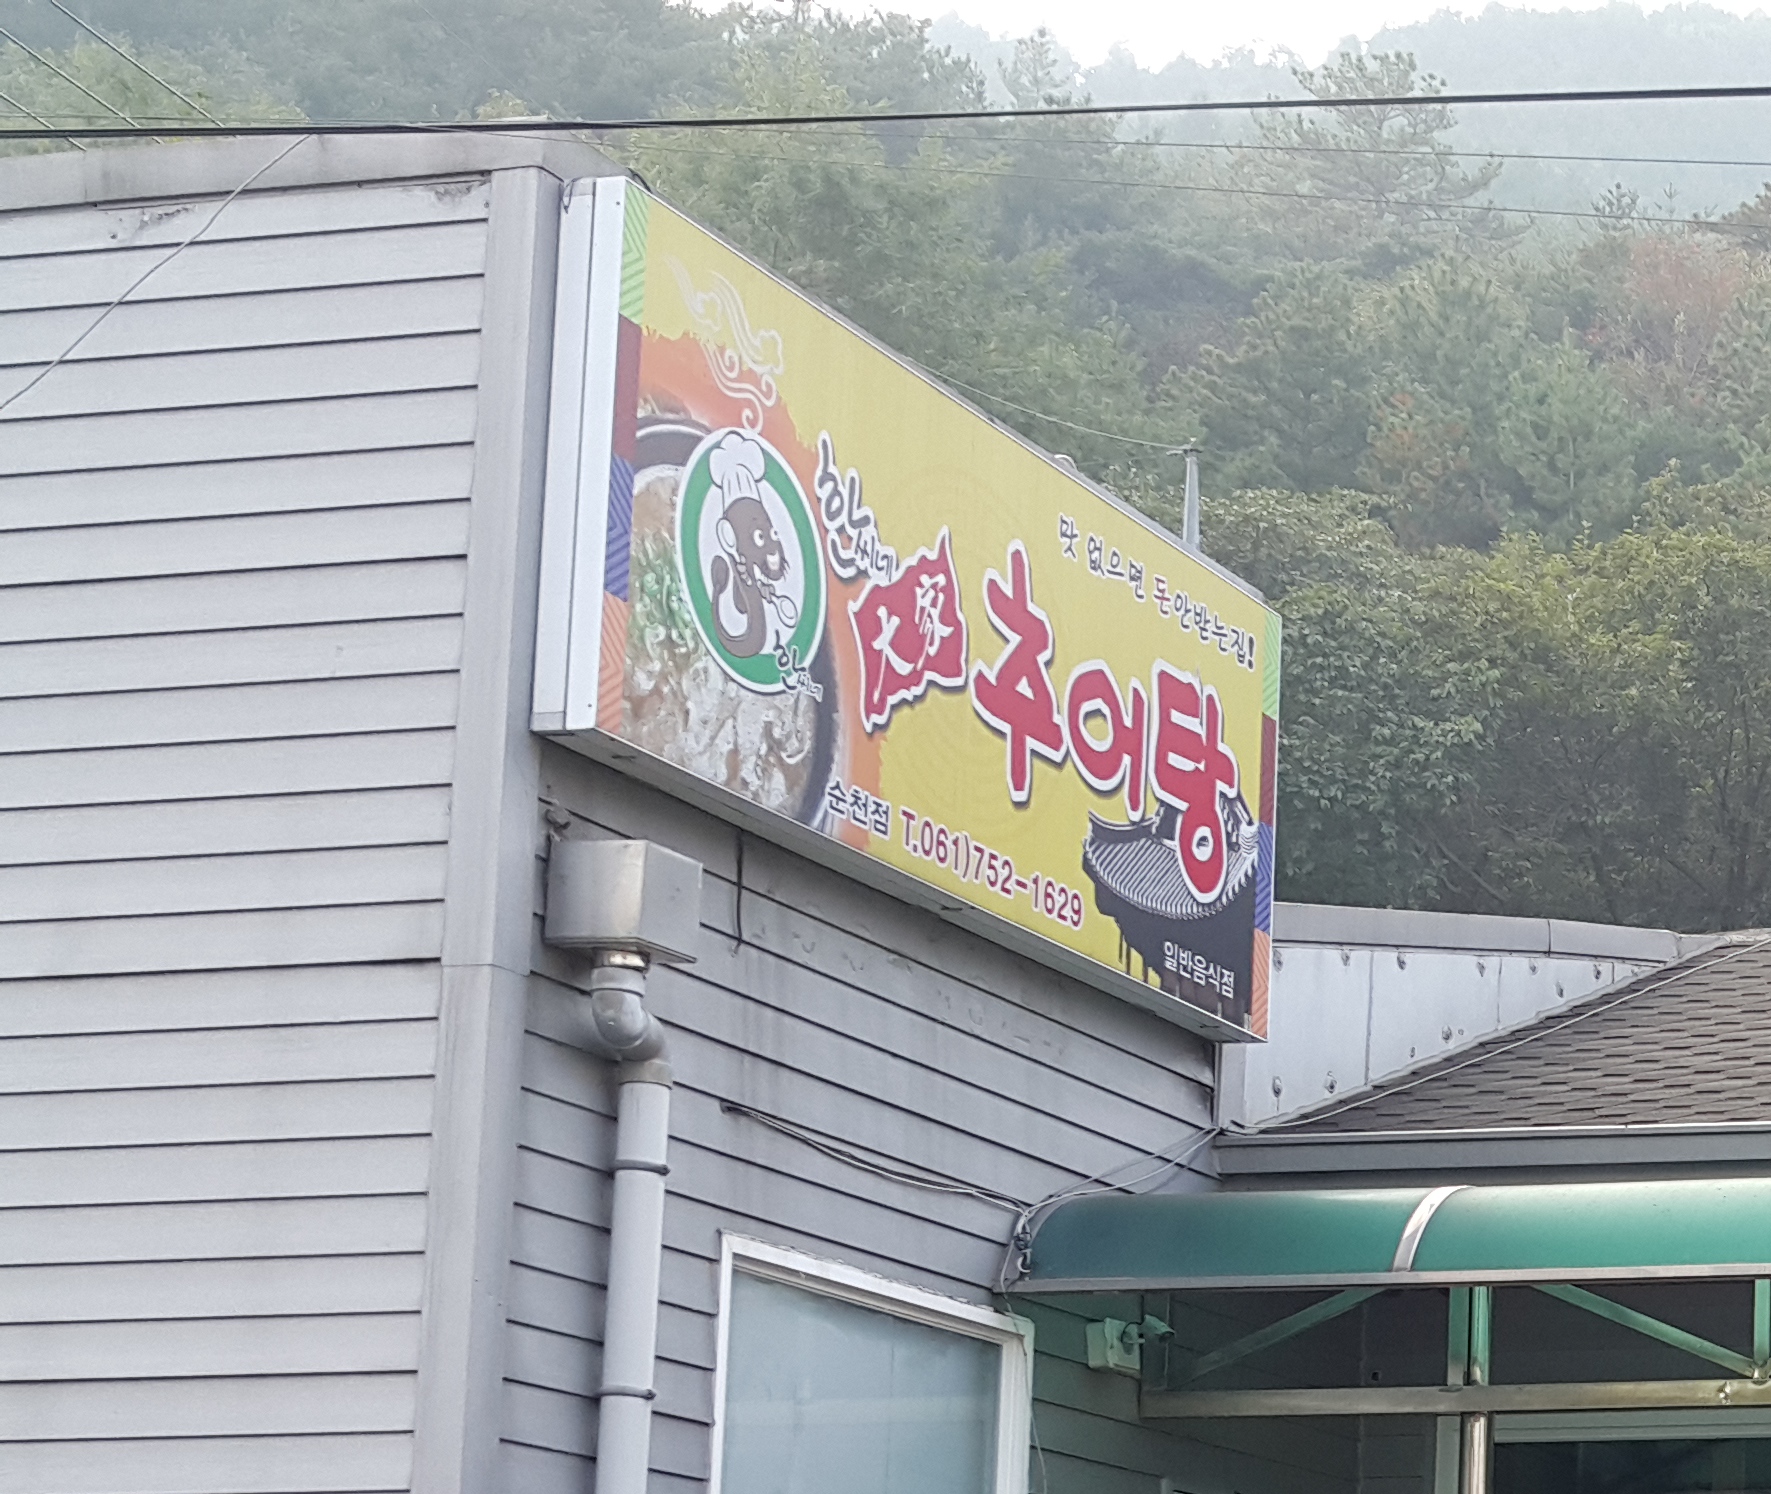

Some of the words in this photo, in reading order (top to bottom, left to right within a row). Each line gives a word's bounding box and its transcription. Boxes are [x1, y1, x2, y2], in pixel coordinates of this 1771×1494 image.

[1059, 514, 1078, 559] 맛
[1087, 536, 1145, 600] 없으면
[972, 541, 1239, 901] 추어탕
[827, 778, 891, 839] 순천점
[900, 809, 1084, 929] T.061)752-1629
[1163, 941, 1235, 999] 일반음식점
